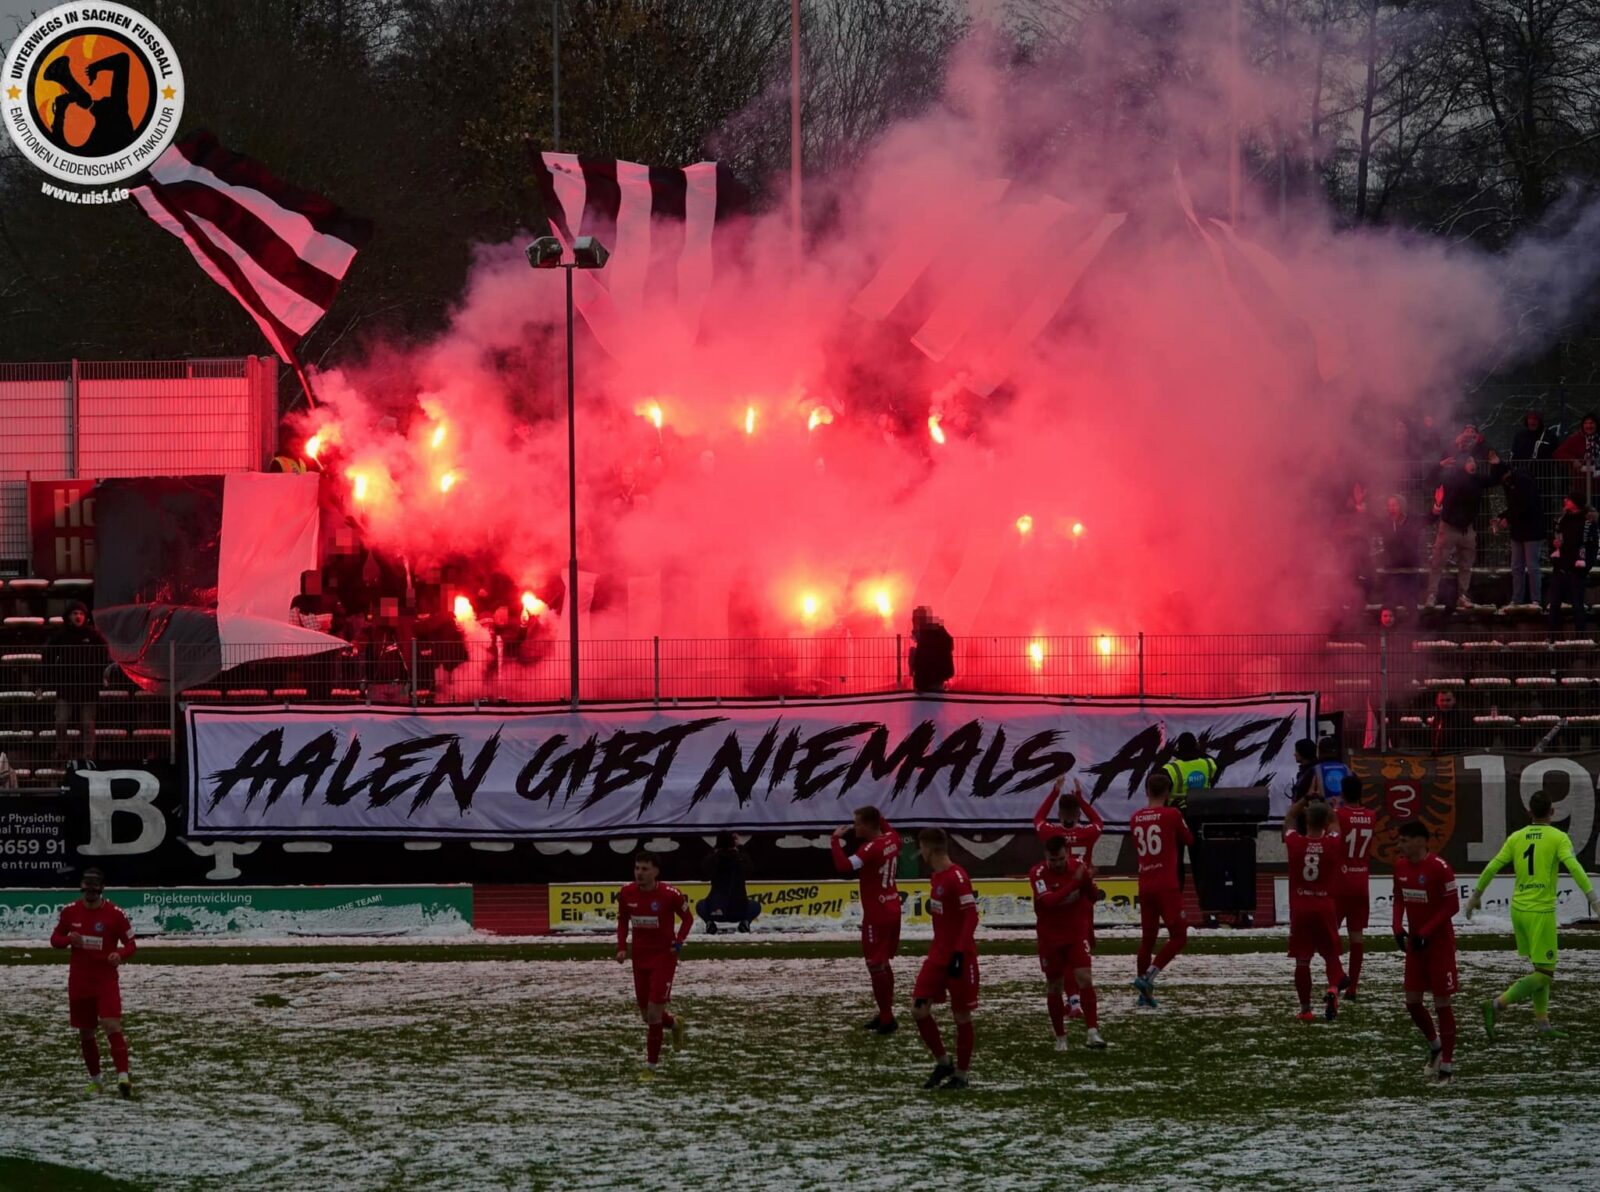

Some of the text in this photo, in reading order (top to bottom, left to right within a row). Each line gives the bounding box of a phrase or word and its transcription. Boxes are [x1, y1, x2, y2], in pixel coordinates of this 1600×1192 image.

[203, 724, 505, 820] AALEN
[516, 715, 731, 820] GIBT
[686, 714, 1075, 813] NIEMALS
[14, 824, 59, 836] Training
[1133, 824, 1162, 857] 36
[1345, 828, 1373, 858] 17
[1302, 854, 1320, 882] 8
[1523, 843, 1536, 876] 1
[143, 893, 253, 906] Projektentwicklung
[355, 894, 382, 907] TEAM!
[560, 891, 604, 905] 2500
[808, 898, 843, 916] 1971!
